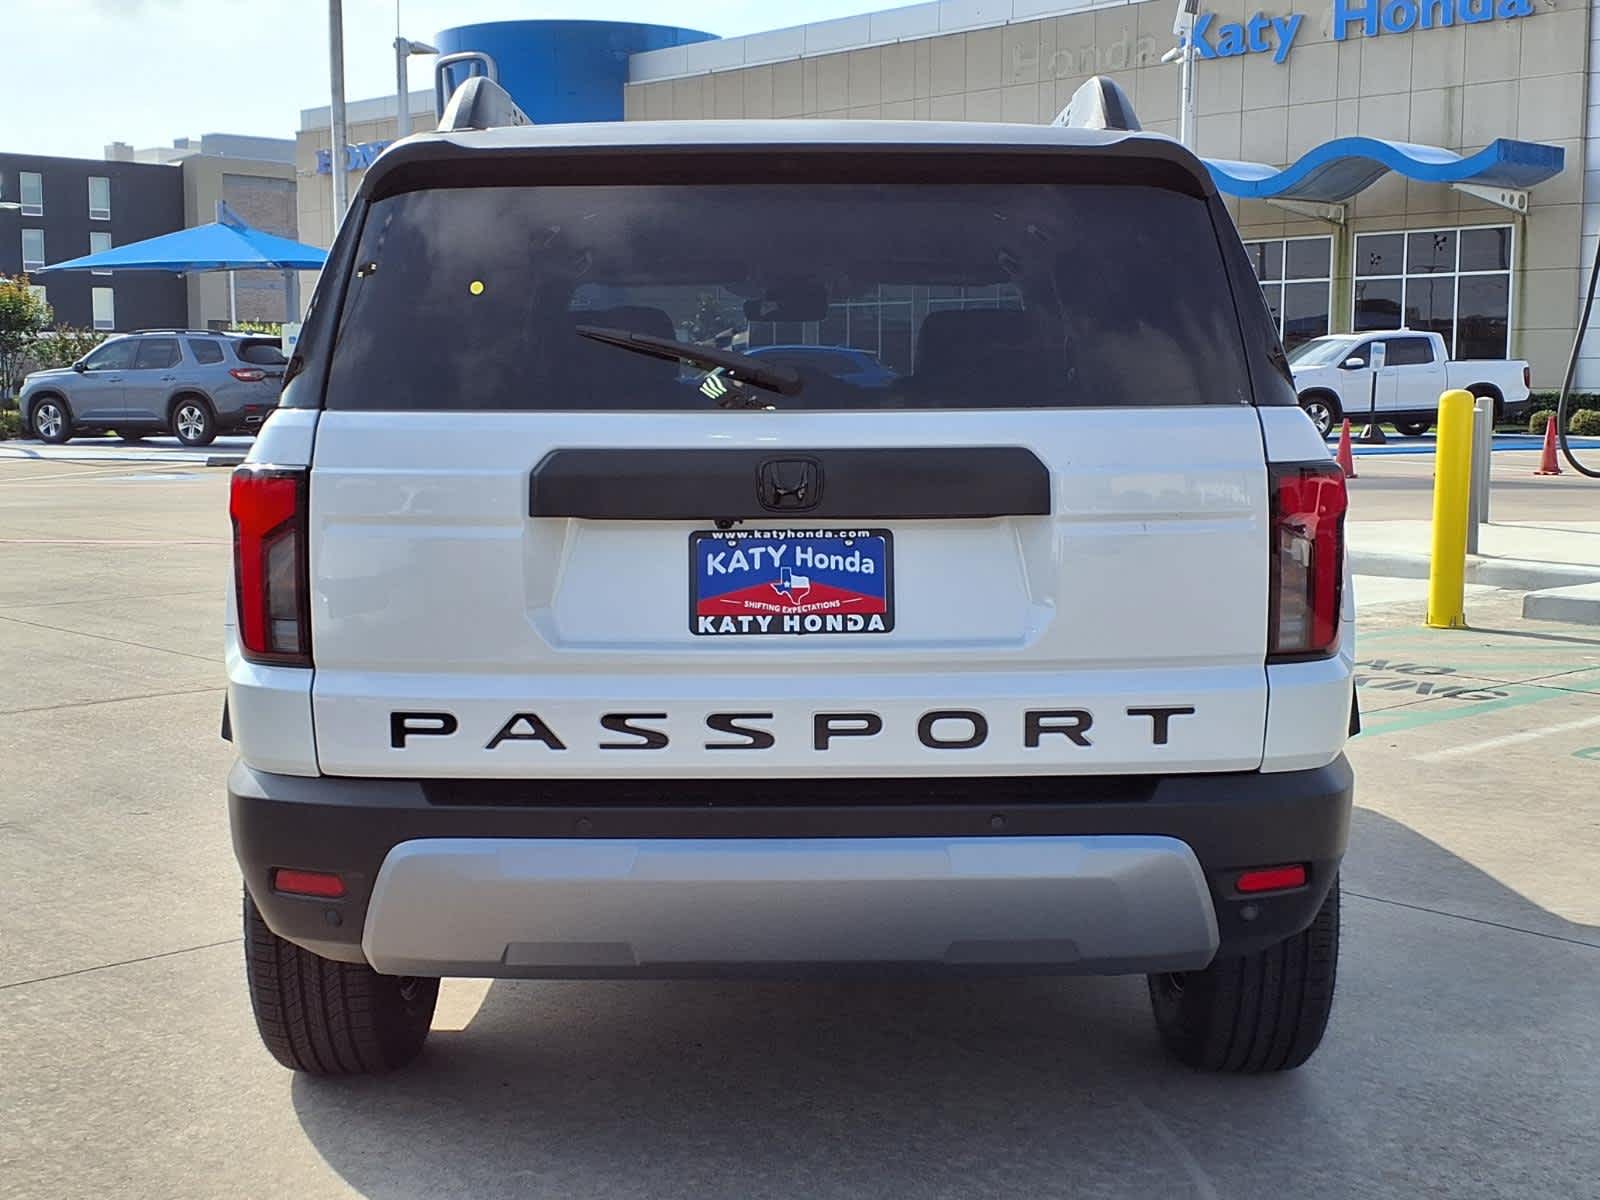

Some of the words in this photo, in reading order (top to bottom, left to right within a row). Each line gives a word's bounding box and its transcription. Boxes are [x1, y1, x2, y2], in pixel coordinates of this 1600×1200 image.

[1180, 11, 1304, 64] Katy
[711, 530, 870, 540] www.katyhonda.com
[706, 544, 787, 576] KATY
[795, 546, 875, 575] Honda
[744, 600, 781, 613] SHIFTING
[782, 600, 841, 614] EXPECTATIONS
[698, 616, 773, 633] KATY
[783, 614, 886, 632] HONDA
[390, 707, 1195, 750] PASSPORT
